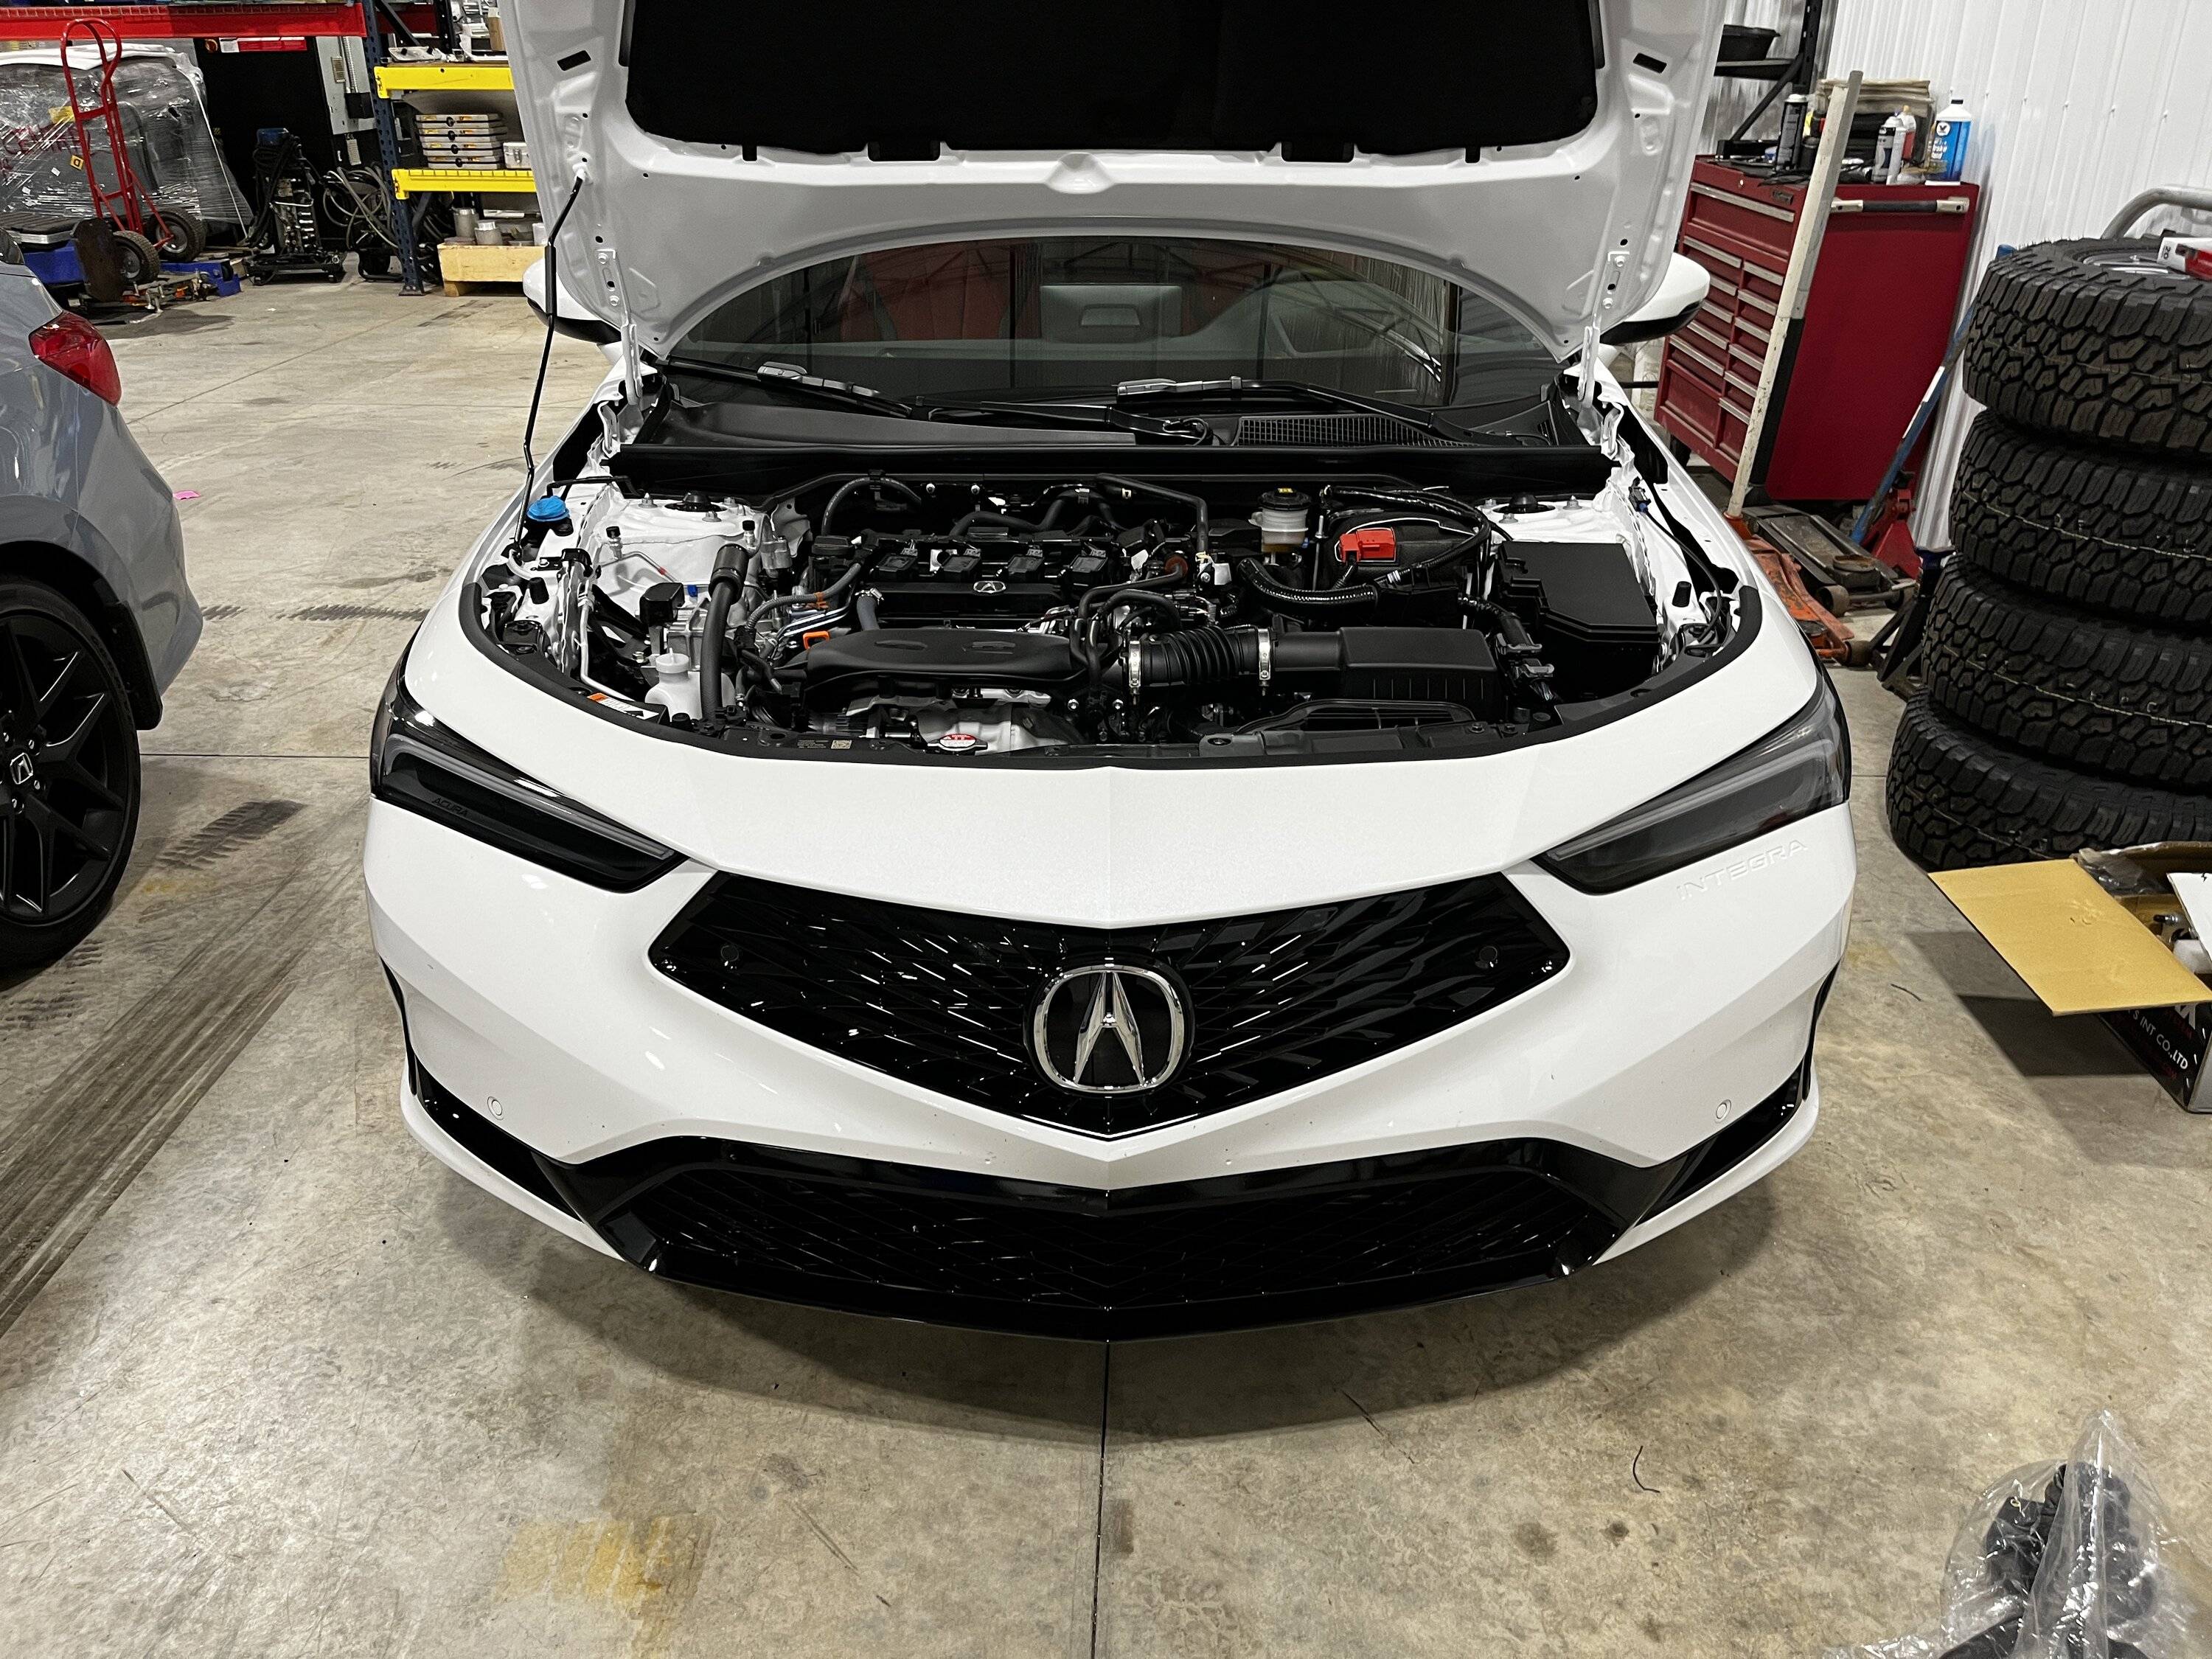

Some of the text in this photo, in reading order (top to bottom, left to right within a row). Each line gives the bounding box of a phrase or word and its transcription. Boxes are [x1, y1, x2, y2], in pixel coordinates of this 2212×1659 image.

[432, 796, 468, 818] ACURA
[1676, 838, 1809, 900] INTEGRA
[2140, 1016, 2157, 1035] INT
